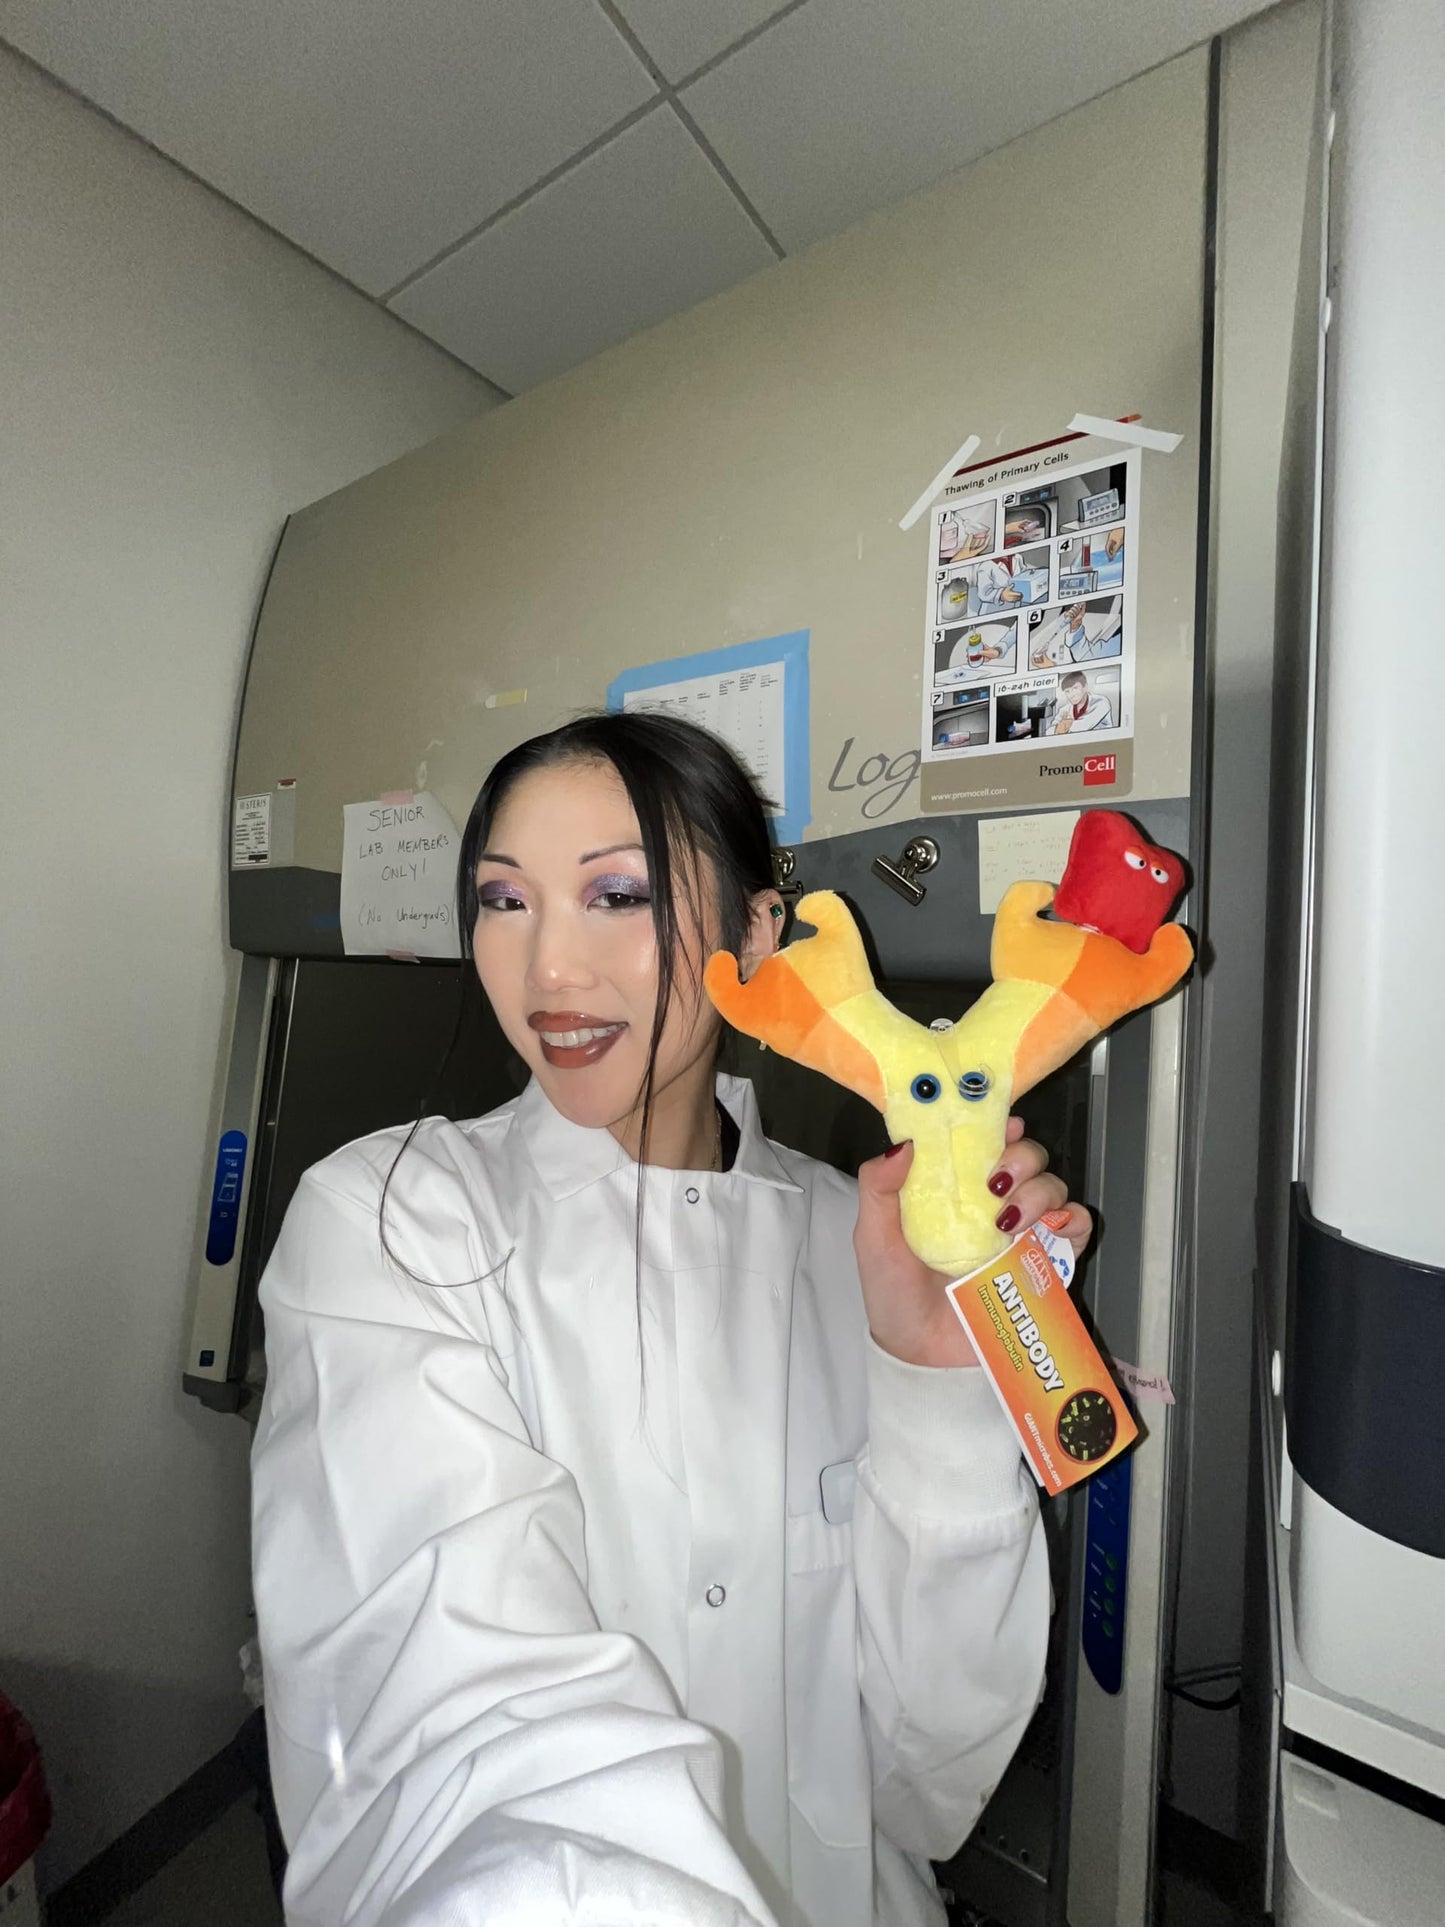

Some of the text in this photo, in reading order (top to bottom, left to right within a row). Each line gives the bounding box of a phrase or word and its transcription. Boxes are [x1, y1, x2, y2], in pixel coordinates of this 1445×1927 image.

[944, 452, 1069, 496] Thawing of Primary Cells
[1004, 494, 1015, 504] 2
[942, 513, 947, 523] 1
[1059, 540, 1070, 551] 4
[937, 571, 946, 581] 3
[1029, 611, 1039, 621] 6
[934, 632, 942, 642] 5
[933, 694, 941, 703] 7
[1039, 754, 1116, 777] PromoCell
[828, 737, 922, 819] Log
[930, 787, 1008, 801] www.promocell.com
[367, 806, 425, 832] SENIOR
[359, 834, 449, 859] LAB MEMBERS
[358, 904, 382, 927] (No
[977, 1284, 1024, 1372] Immunoglobulin
[992, 1271, 1064, 1393] ANTIBODY
[1023, 1412, 1062, 1487] GIANTmicrobes.com
